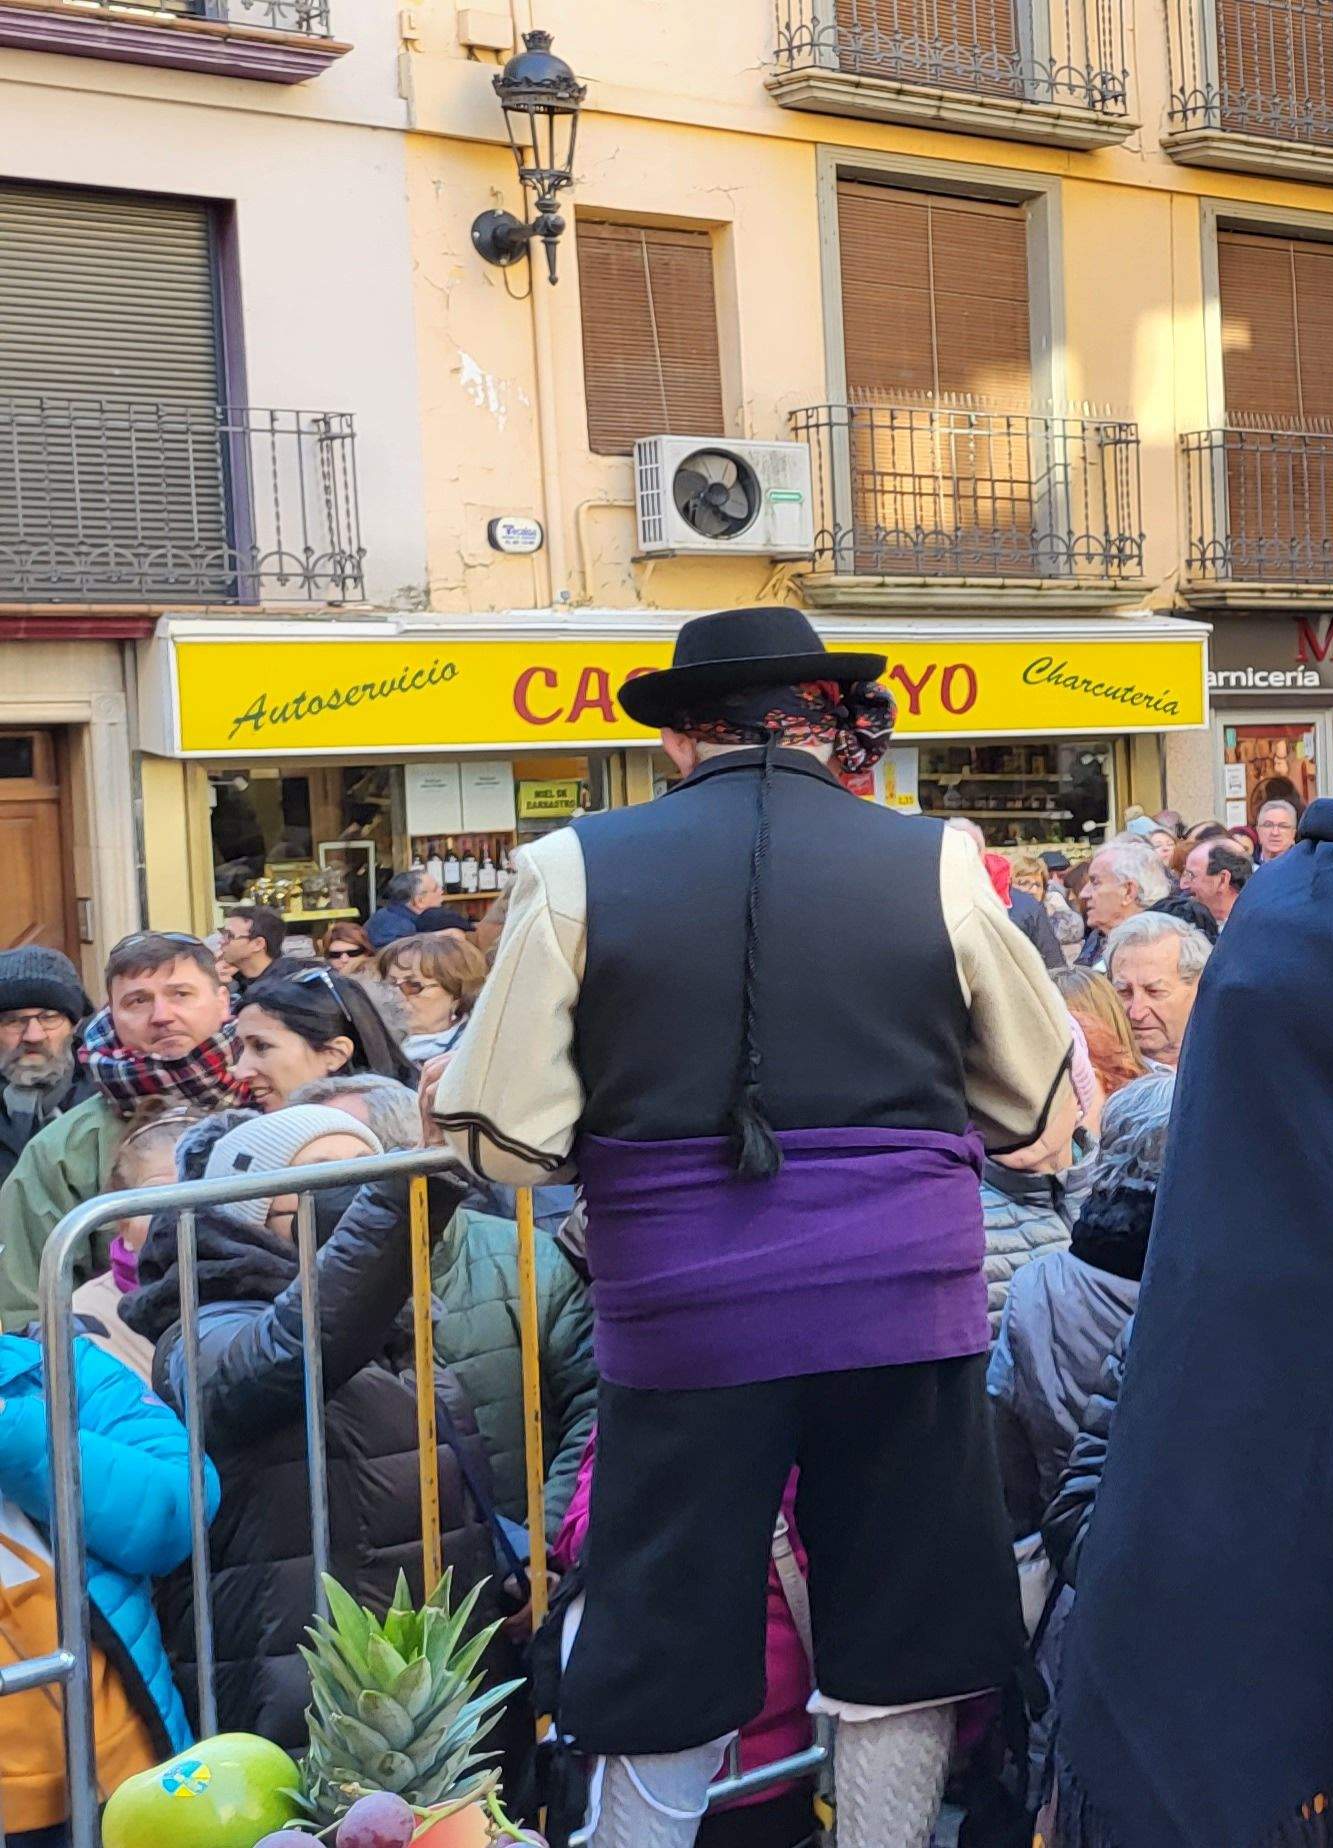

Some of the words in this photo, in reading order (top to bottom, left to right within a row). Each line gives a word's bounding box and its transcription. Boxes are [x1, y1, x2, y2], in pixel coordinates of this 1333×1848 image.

[228, 659, 459, 740] Autoservicio
[513, 666, 660, 725] CA
[1022, 656, 1180, 716] Charcutería
[1208, 665, 1320, 687] arnicería
